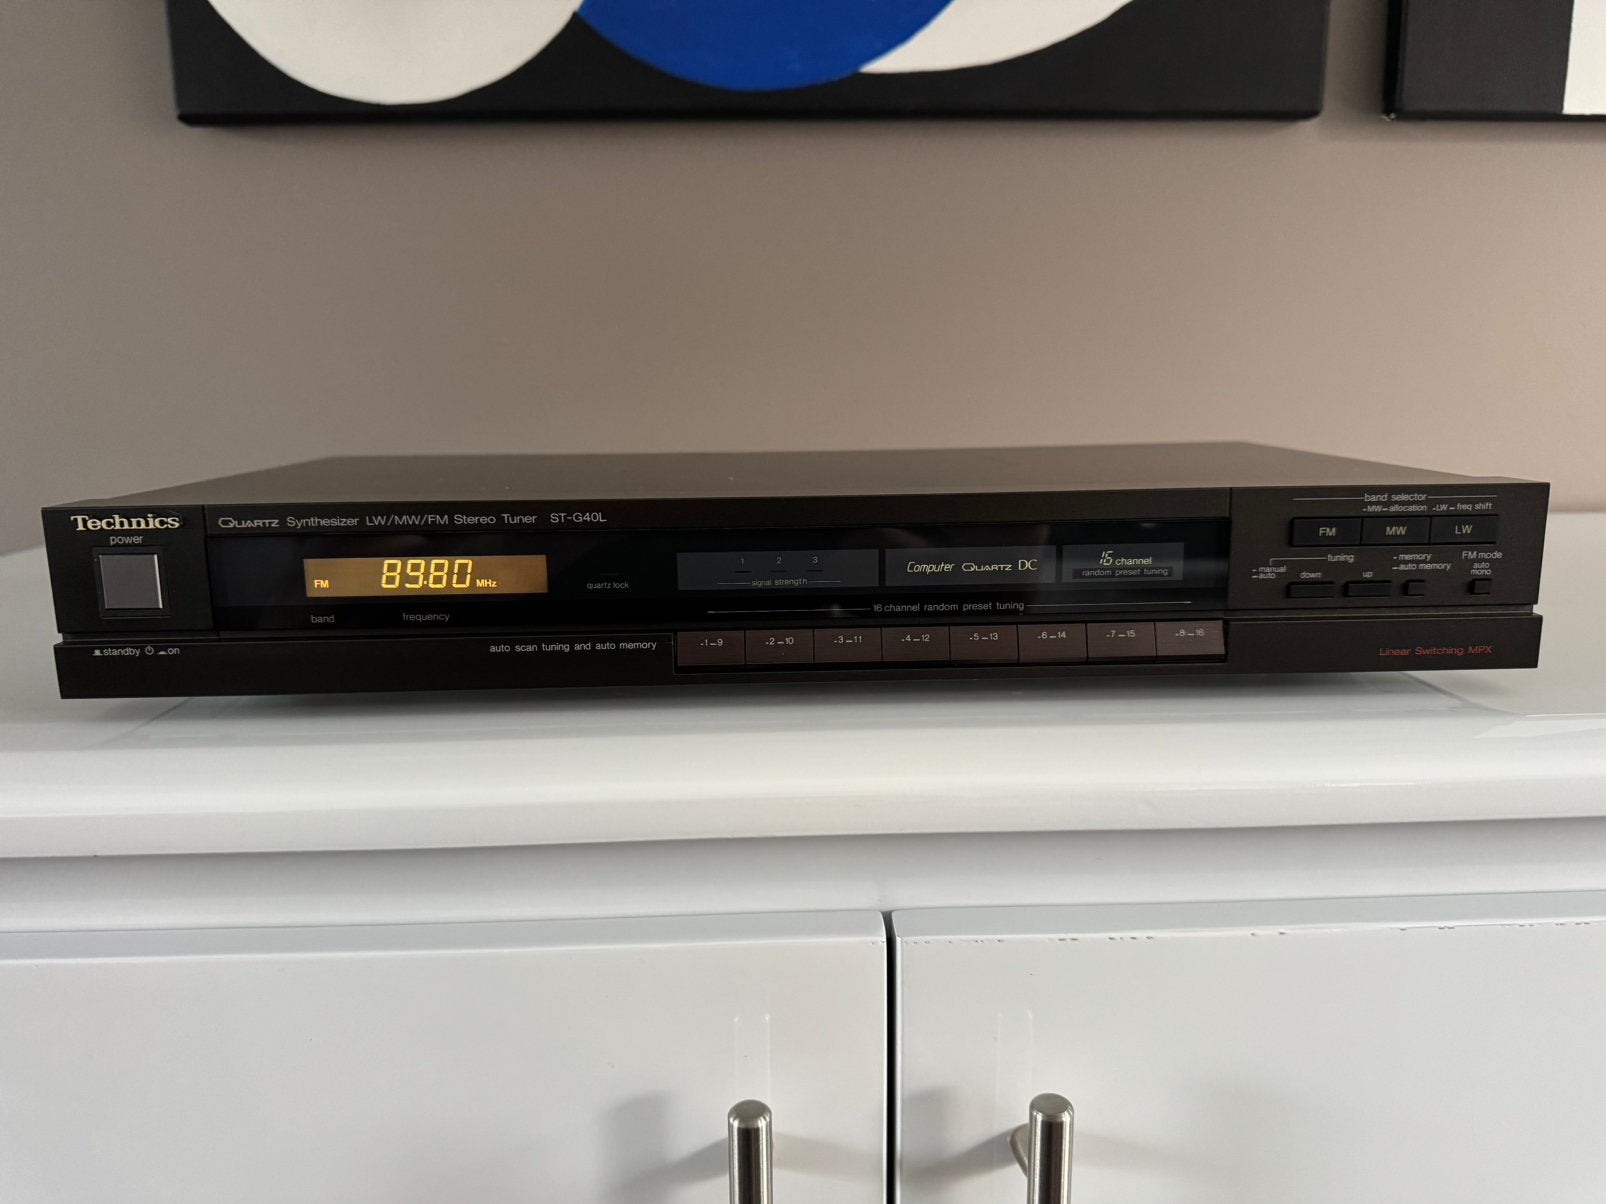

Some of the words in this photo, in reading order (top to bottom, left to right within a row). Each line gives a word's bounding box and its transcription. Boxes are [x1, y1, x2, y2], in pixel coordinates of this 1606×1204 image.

[1364, 493, 1388, 502] band
[1391, 492, 1426, 501] selector
[1457, 503, 1472, 511] freq
[1475, 502, 1492, 510] shift
[71, 514, 180, 530] Technics
[287, 515, 359, 528] Synthesizer
[366, 514, 449, 526] LW/MW/FM
[454, 514, 496, 525] Stereo
[501, 513, 537, 524] Tuner
[550, 512, 607, 524] ST-G40L
[1319, 527, 1336, 536] FM
[1386, 526, 1407, 535] MW
[1455, 525, 1472, 534] LW
[110, 535, 143, 545] power
[1099, 551, 1113, 565] 16
[1115, 556, 1152, 565] channel
[1328, 553, 1354, 562] tuning
[1399, 552, 1431, 561] memory
[1462, 551, 1477, 559] FM
[1478, 550, 1502, 558] mode
[907, 561, 954, 574] Computer
[1018, 560, 1037, 571] DC
[1419, 562, 1451, 571] memory
[1115, 568, 1140, 577] preset
[1144, 567, 1169, 576] tuning
[314, 579, 329, 589] FM
[476, 579, 497, 588] MHz
[586, 581, 611, 590] quartz
[613, 580, 629, 589] lock
[752, 578, 772, 587] signal
[774, 577, 807, 586] strength
[873, 604, 882, 612] 16
[884, 603, 920, 612] channel
[924, 602, 958, 610] random
[962, 601, 992, 611] preset
[996, 600, 1025, 610] tuning
[311, 614, 334, 623] band
[402, 612, 450, 622] frequency
[104, 646, 140, 657] standby
[168, 647, 180, 655] on
[490, 643, 510, 652] auto
[515, 643, 537, 652] scan
[541, 641, 570, 653] tuning
[574, 641, 591, 651] and
[595, 641, 615, 651] auto
[619, 641, 656, 650] memory
[1379, 647, 1410, 656] Linear
[1415, 646, 1464, 656] Switching
[1468, 646, 1492, 654] MPX
